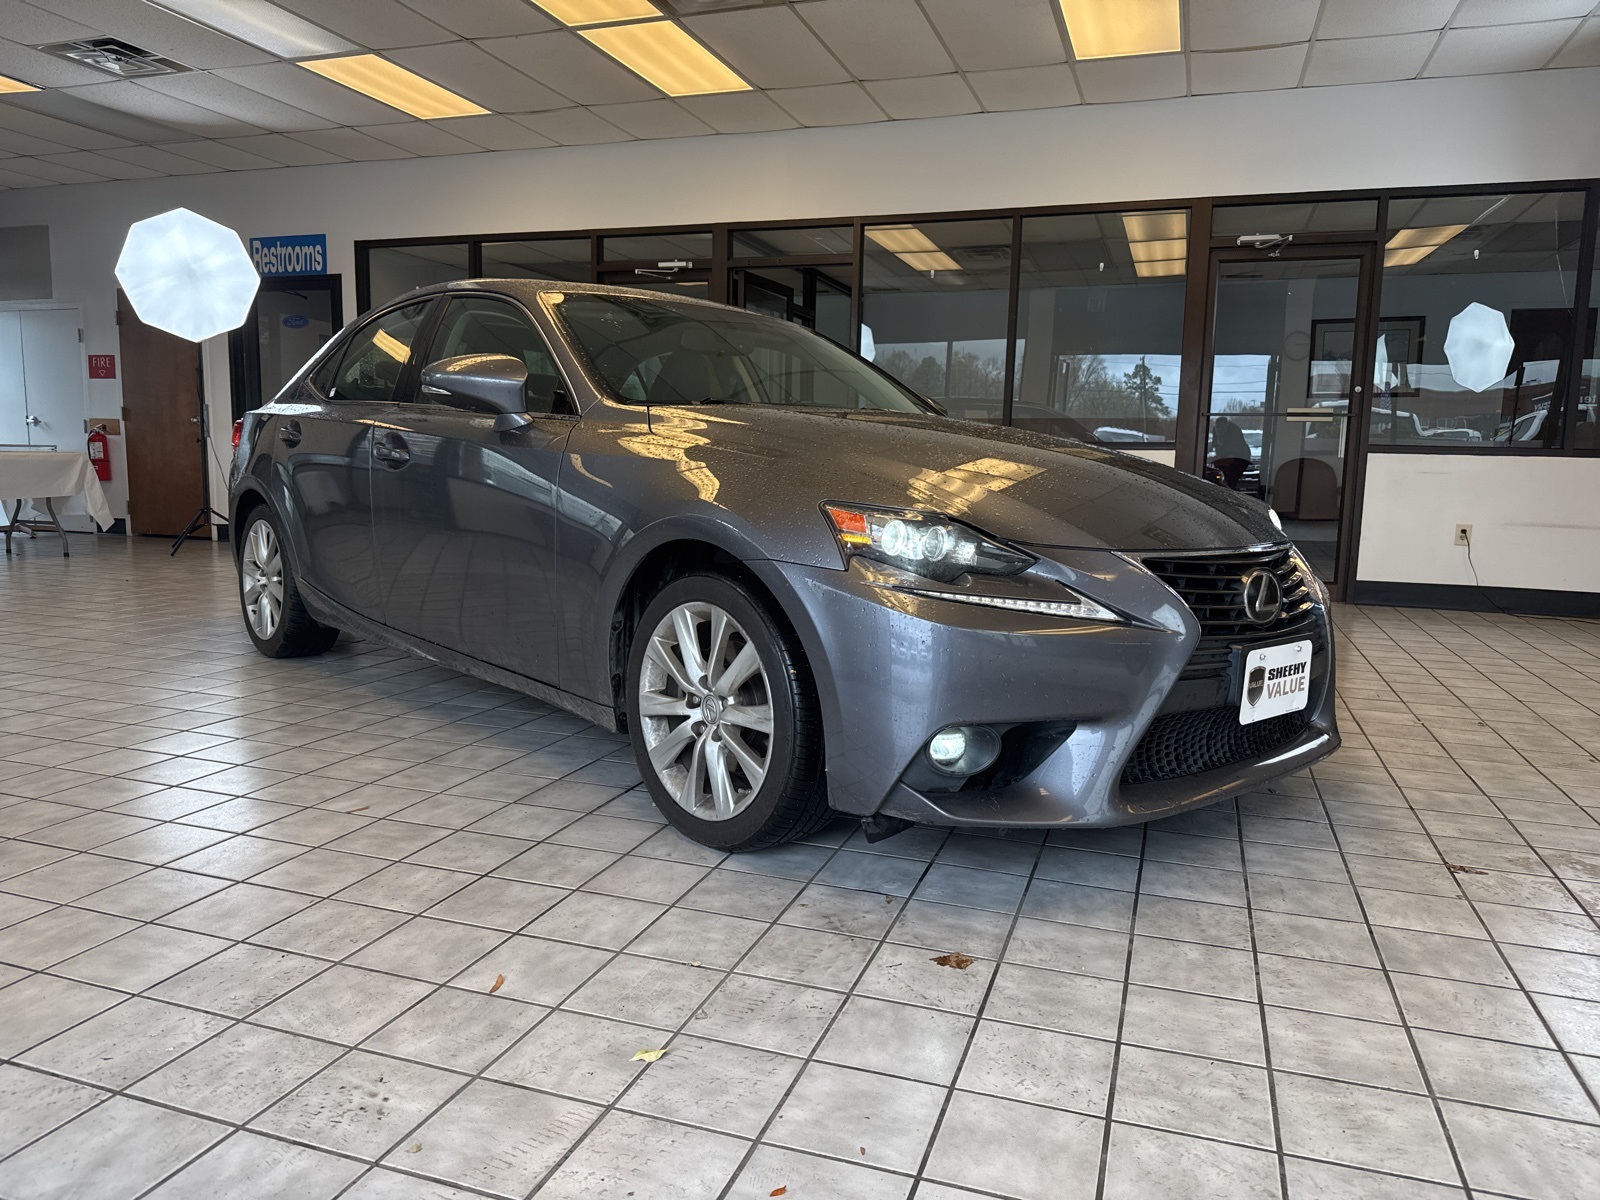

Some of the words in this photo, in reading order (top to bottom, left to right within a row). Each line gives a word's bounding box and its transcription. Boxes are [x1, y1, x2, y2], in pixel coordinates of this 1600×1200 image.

[252, 240, 323, 274] Restrooms
[92, 356, 111, 368] FIRE
[1267, 661, 1307, 681] SHEEHY
[1266, 676, 1306, 699] VALUE
